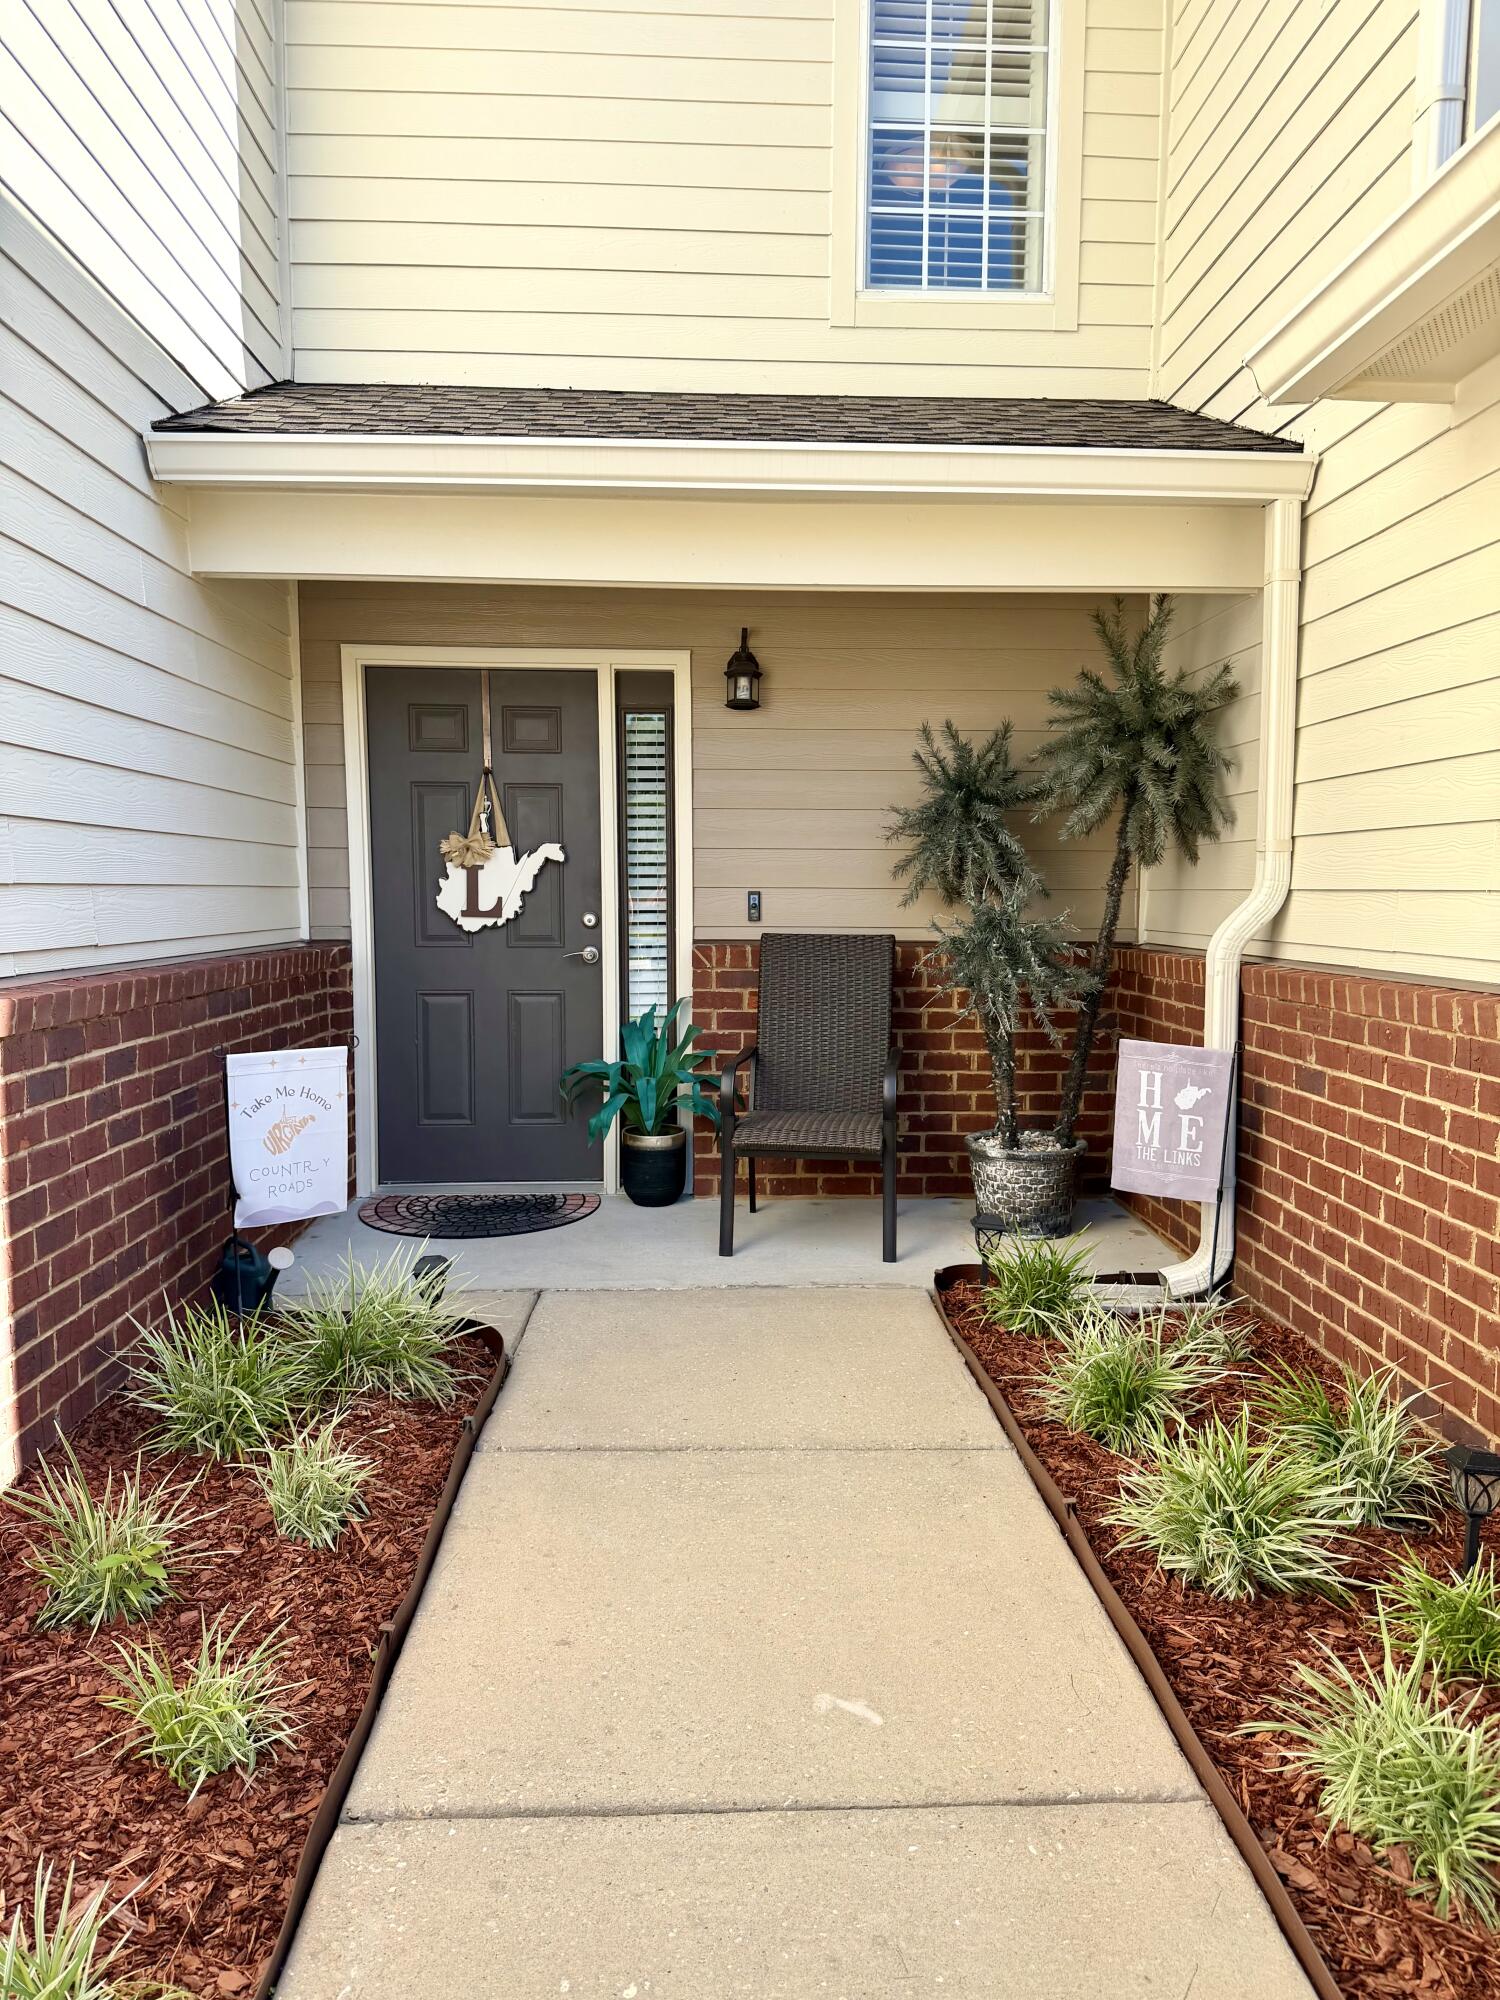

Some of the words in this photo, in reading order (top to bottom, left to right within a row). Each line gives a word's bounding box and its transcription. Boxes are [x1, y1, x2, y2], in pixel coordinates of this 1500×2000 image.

[461, 864, 502, 918] L
[240, 1093, 272, 1119] Take
[275, 1085, 295, 1100] Me
[299, 1085, 332, 1112] Home
[1136, 1145, 1157, 1161] THE
[1163, 1149, 1201, 1167] LINKS
[268, 1179, 313, 1199] ROADS
